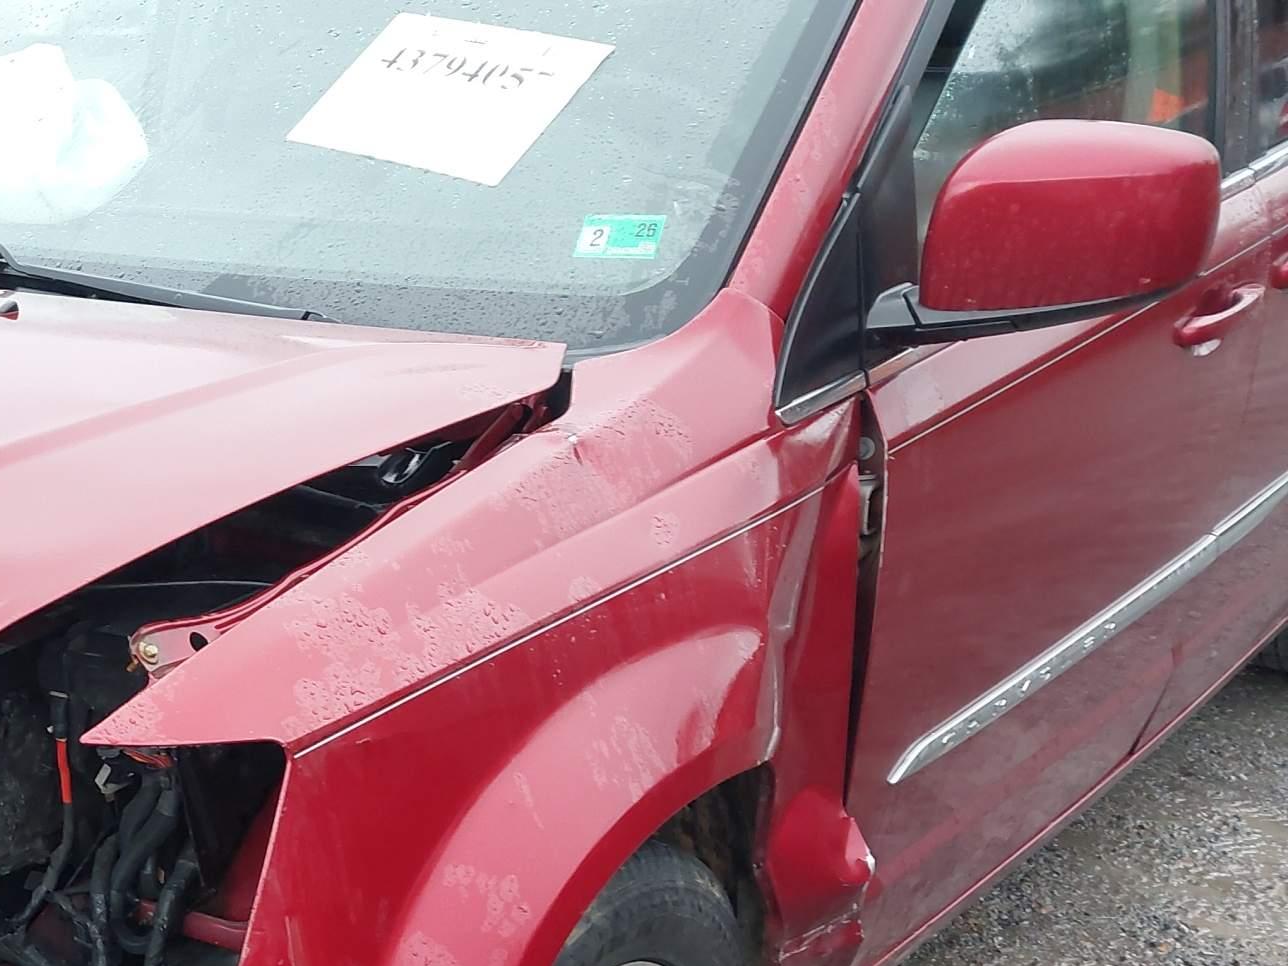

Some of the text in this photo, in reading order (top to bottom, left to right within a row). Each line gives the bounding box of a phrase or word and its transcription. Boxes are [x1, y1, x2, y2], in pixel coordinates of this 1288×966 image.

[589, 228, 604, 247] 2
[634, 222, 658, 237] 26
[941, 622, 1116, 744] CRYSER
